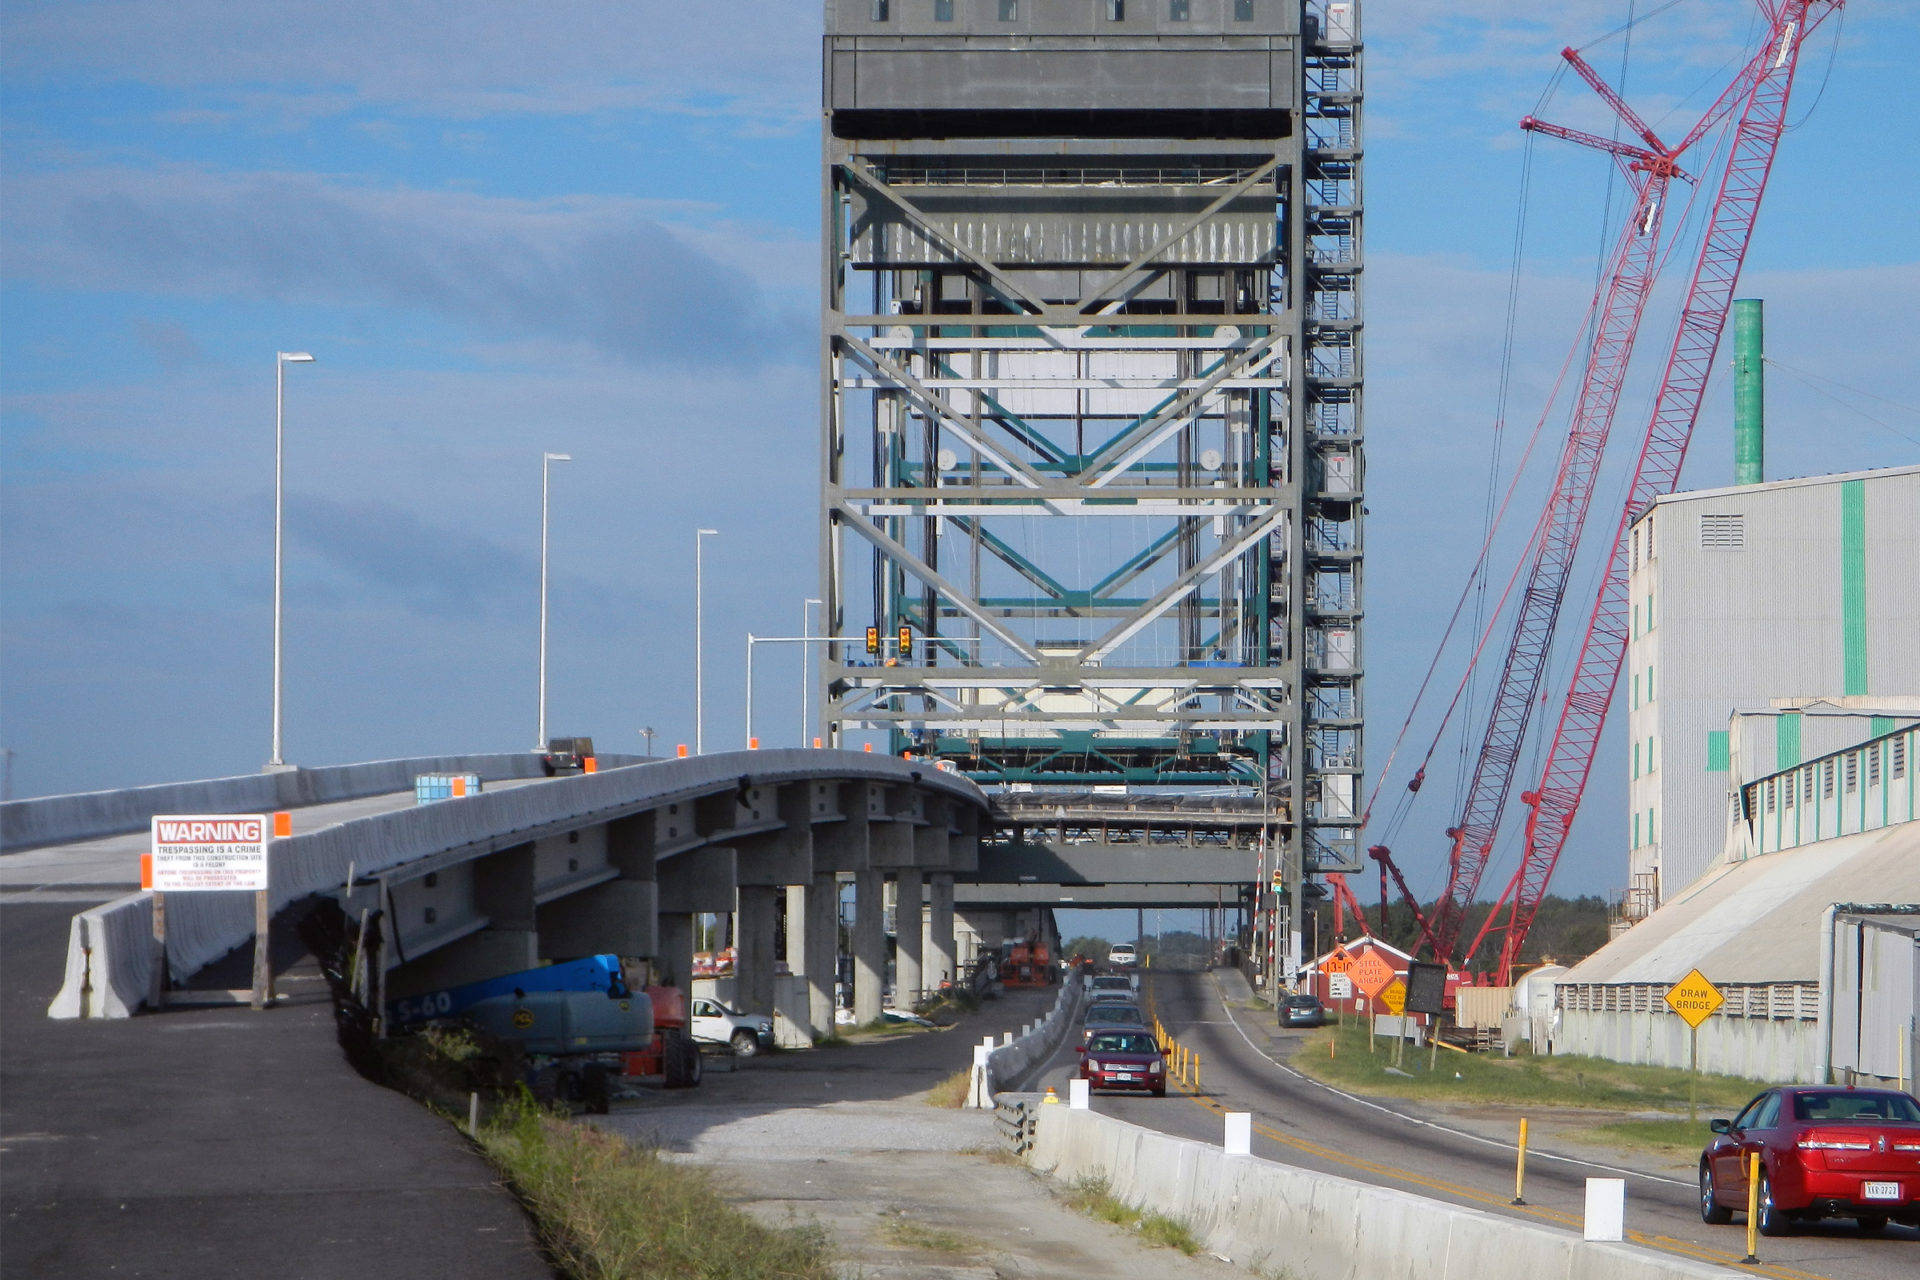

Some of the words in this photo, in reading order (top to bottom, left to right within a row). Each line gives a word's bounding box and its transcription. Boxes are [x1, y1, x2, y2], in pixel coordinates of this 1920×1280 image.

[159, 822, 260, 841] WARNING
[158, 846, 214, 854] TRESPASSING
[217, 846, 225, 854] IS
[235, 845, 261, 853] CRIME
[1681, 989, 1708, 998] DRAW
[397, 991, 451, 1022] S-60
[1676, 1000, 1711, 1010] BRIDGE
